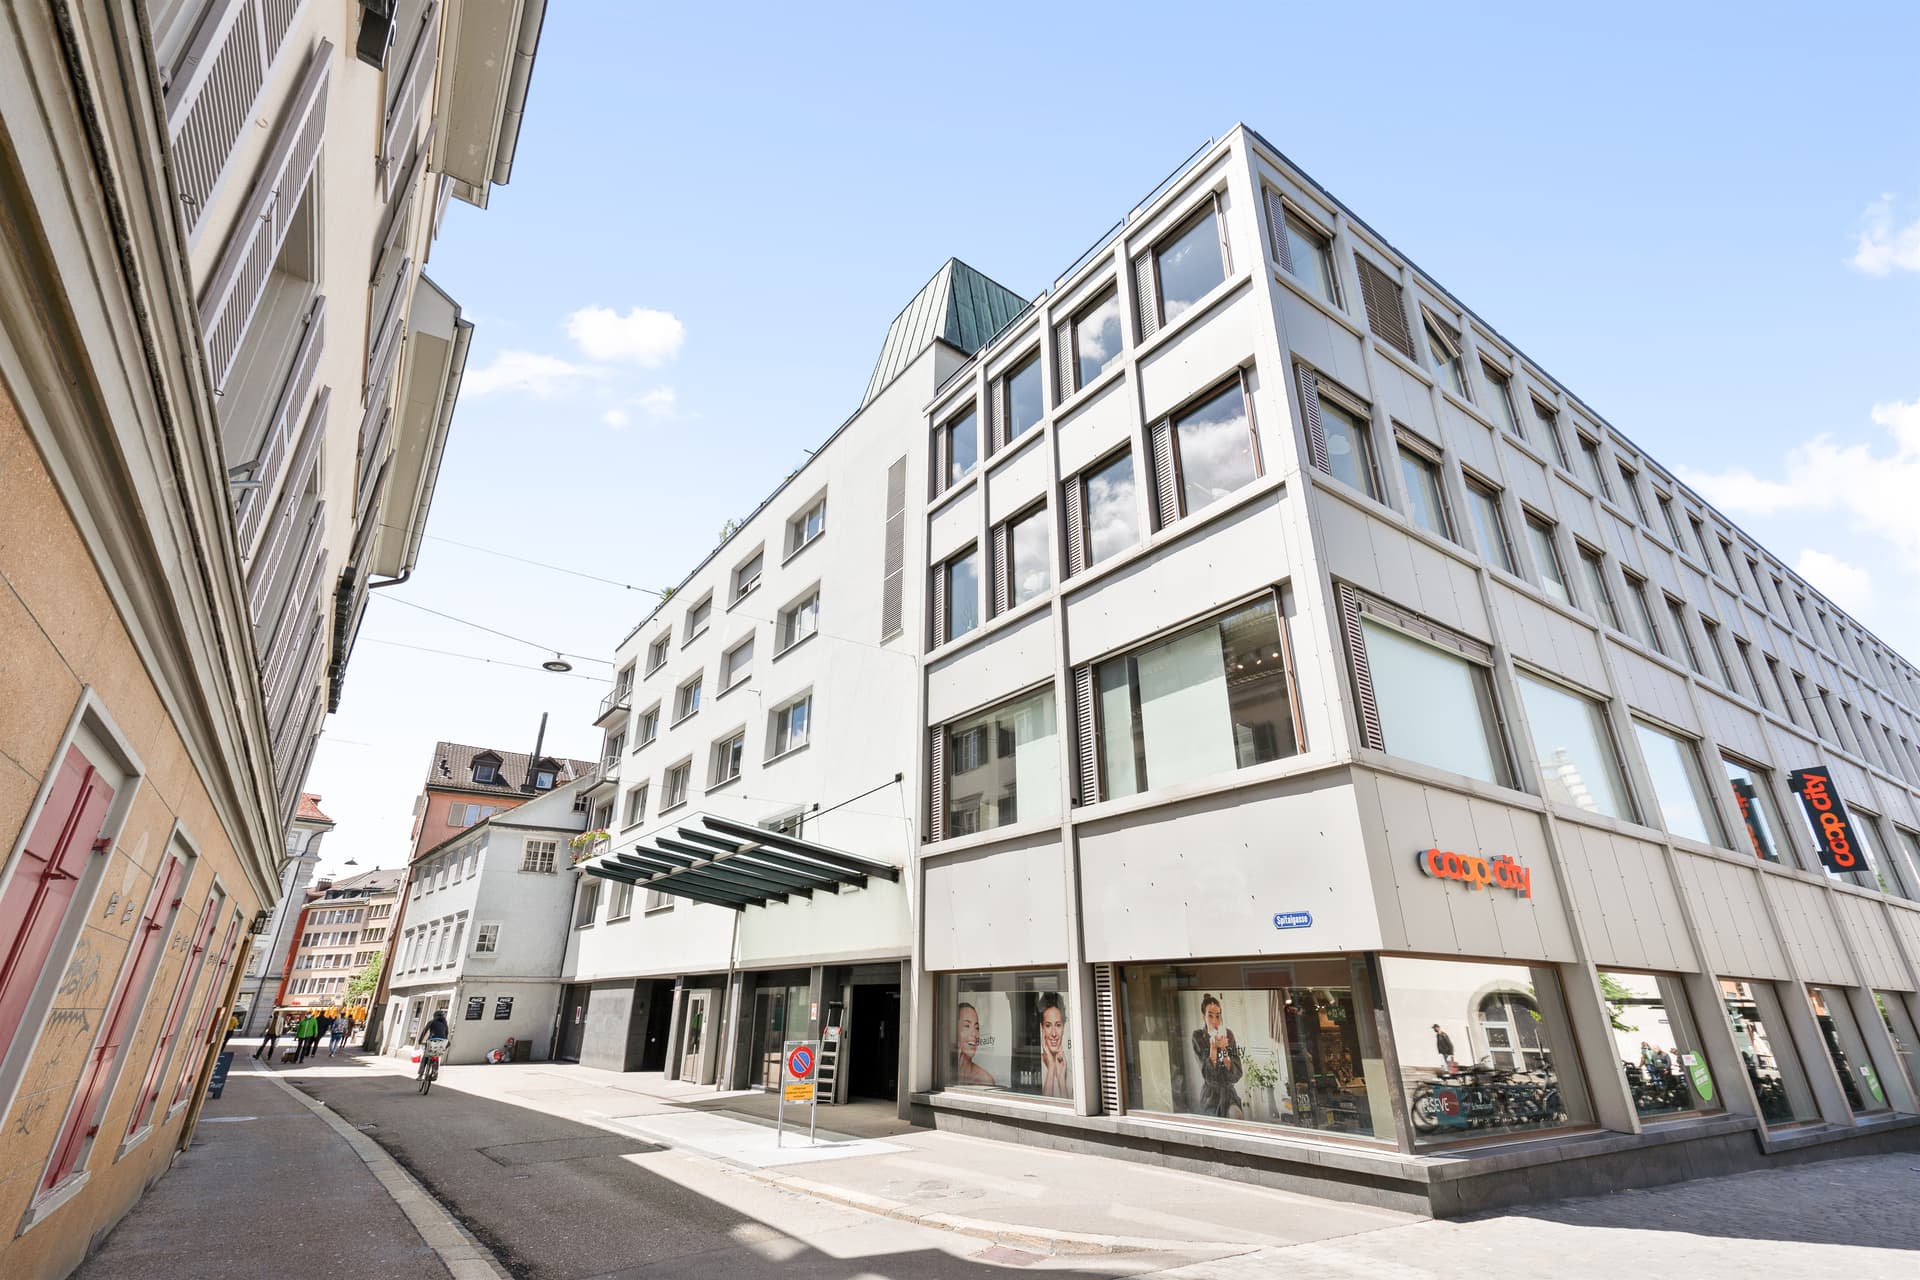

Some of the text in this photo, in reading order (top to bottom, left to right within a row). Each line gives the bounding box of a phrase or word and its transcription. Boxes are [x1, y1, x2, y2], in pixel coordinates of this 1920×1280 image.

[1801, 773, 1855, 868] coop city
[1424, 848, 1531, 899] coop city
[1276, 914, 1308, 926] Spitalgasse
[975, 1036, 995, 1047] Beauty
